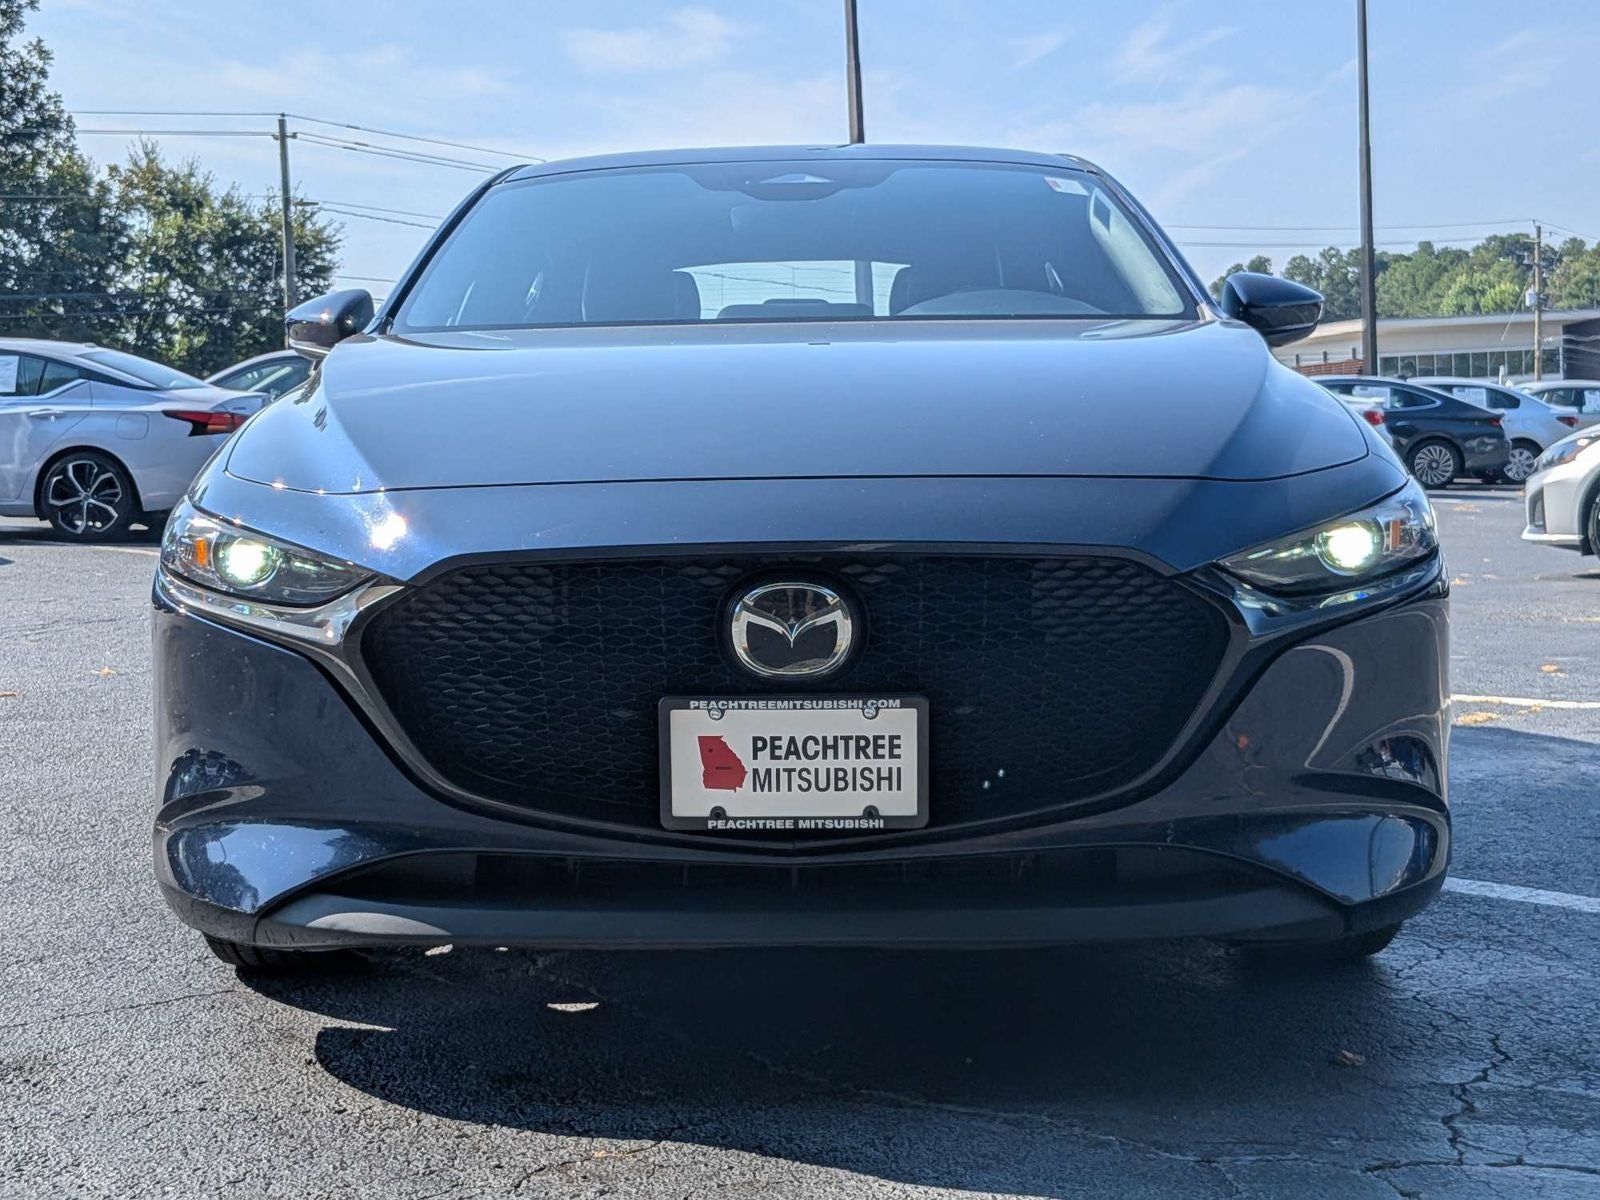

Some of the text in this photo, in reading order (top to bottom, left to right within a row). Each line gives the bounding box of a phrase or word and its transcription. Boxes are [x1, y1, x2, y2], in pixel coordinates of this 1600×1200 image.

[689, 699, 901, 709] PEACHTREEMITSUBISHI.COM
[752, 735, 902, 760] PEACHTREE
[752, 767, 902, 792] MITSUBISHI
[707, 818, 884, 829] PEACHTREE MITSUBISHI
